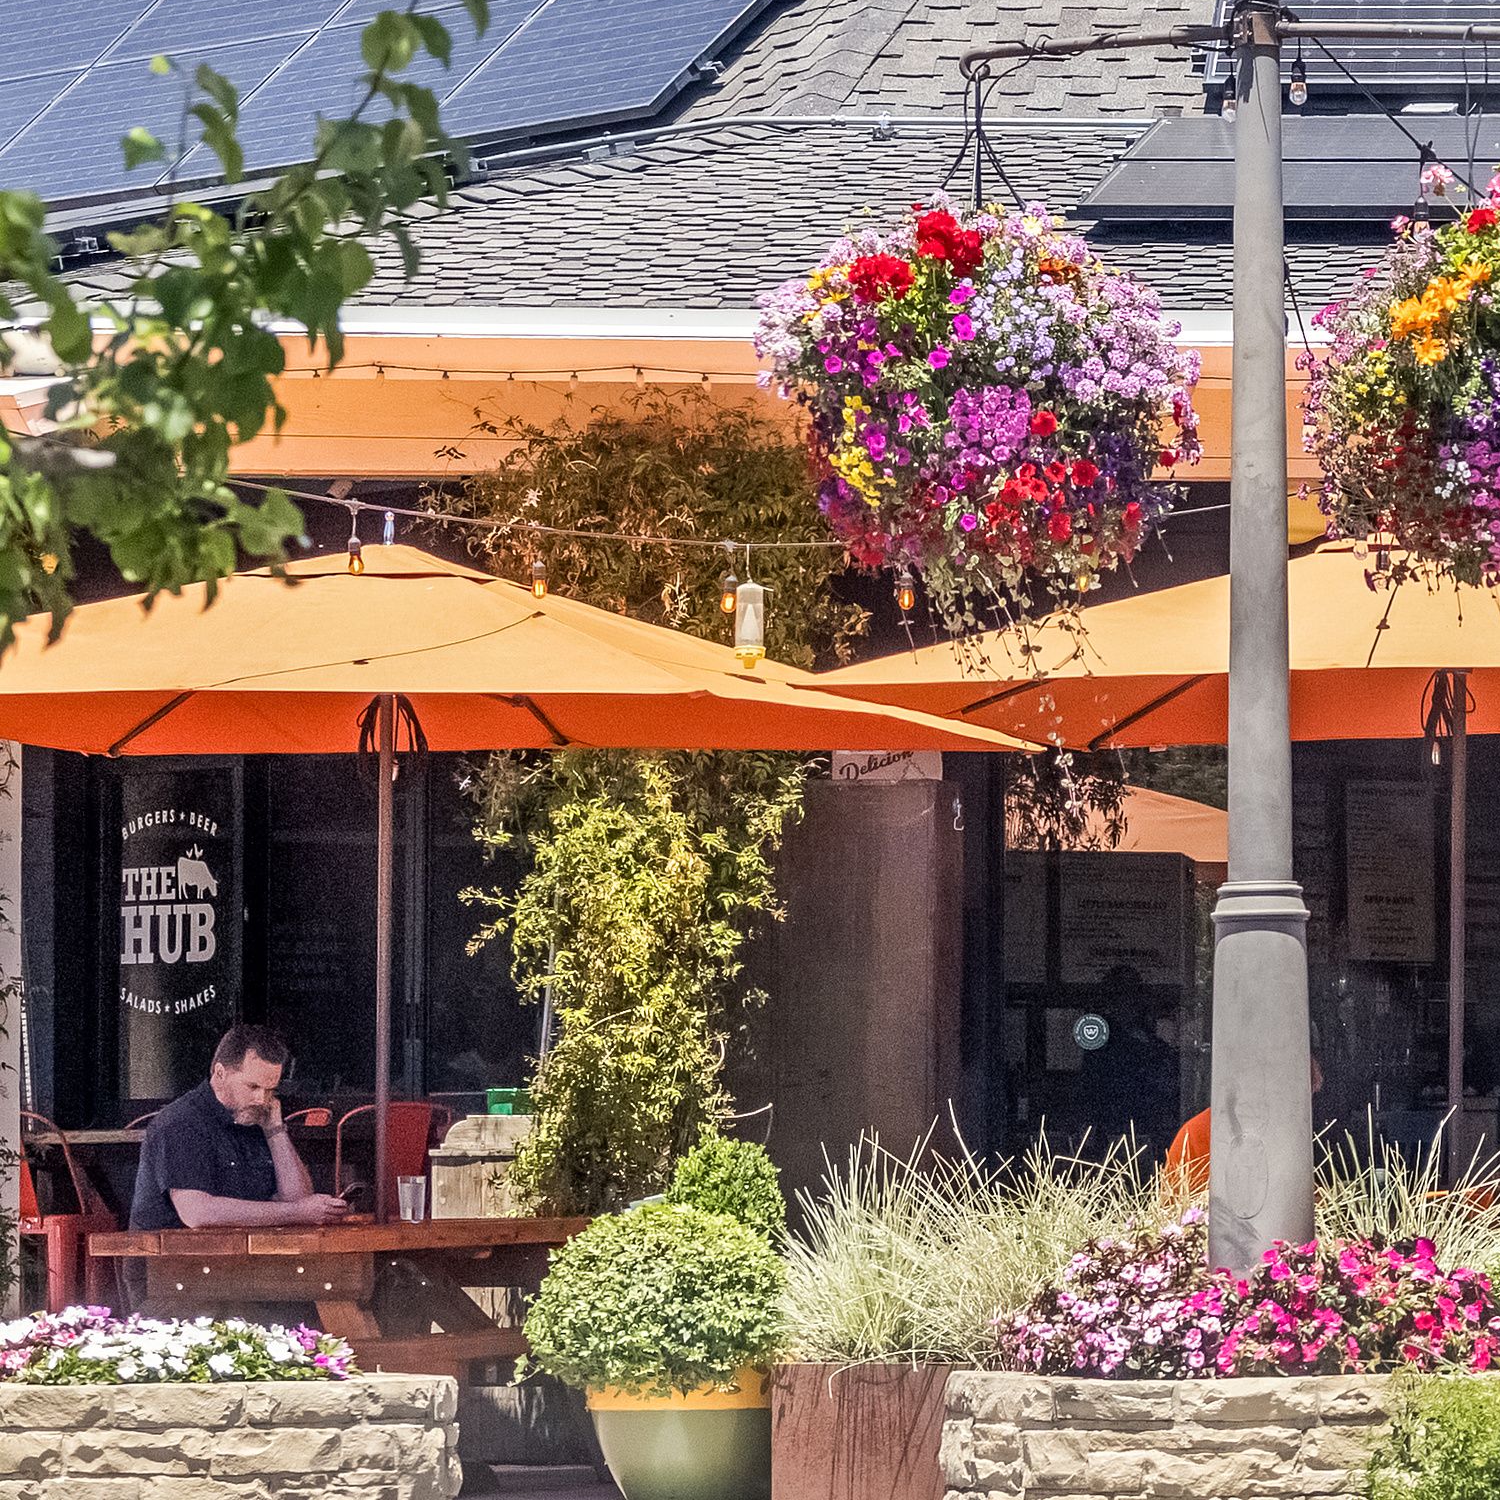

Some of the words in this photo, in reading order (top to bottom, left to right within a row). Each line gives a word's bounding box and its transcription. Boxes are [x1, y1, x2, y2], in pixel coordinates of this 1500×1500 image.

[122, 809, 176, 840] BURGERS
[189, 812, 218, 837] BEER
[122, 866, 176, 901] THE
[120, 903, 216, 965] HUB
[119, 987, 162, 1015] SALADS
[174, 985, 216, 1015] SHAKES
